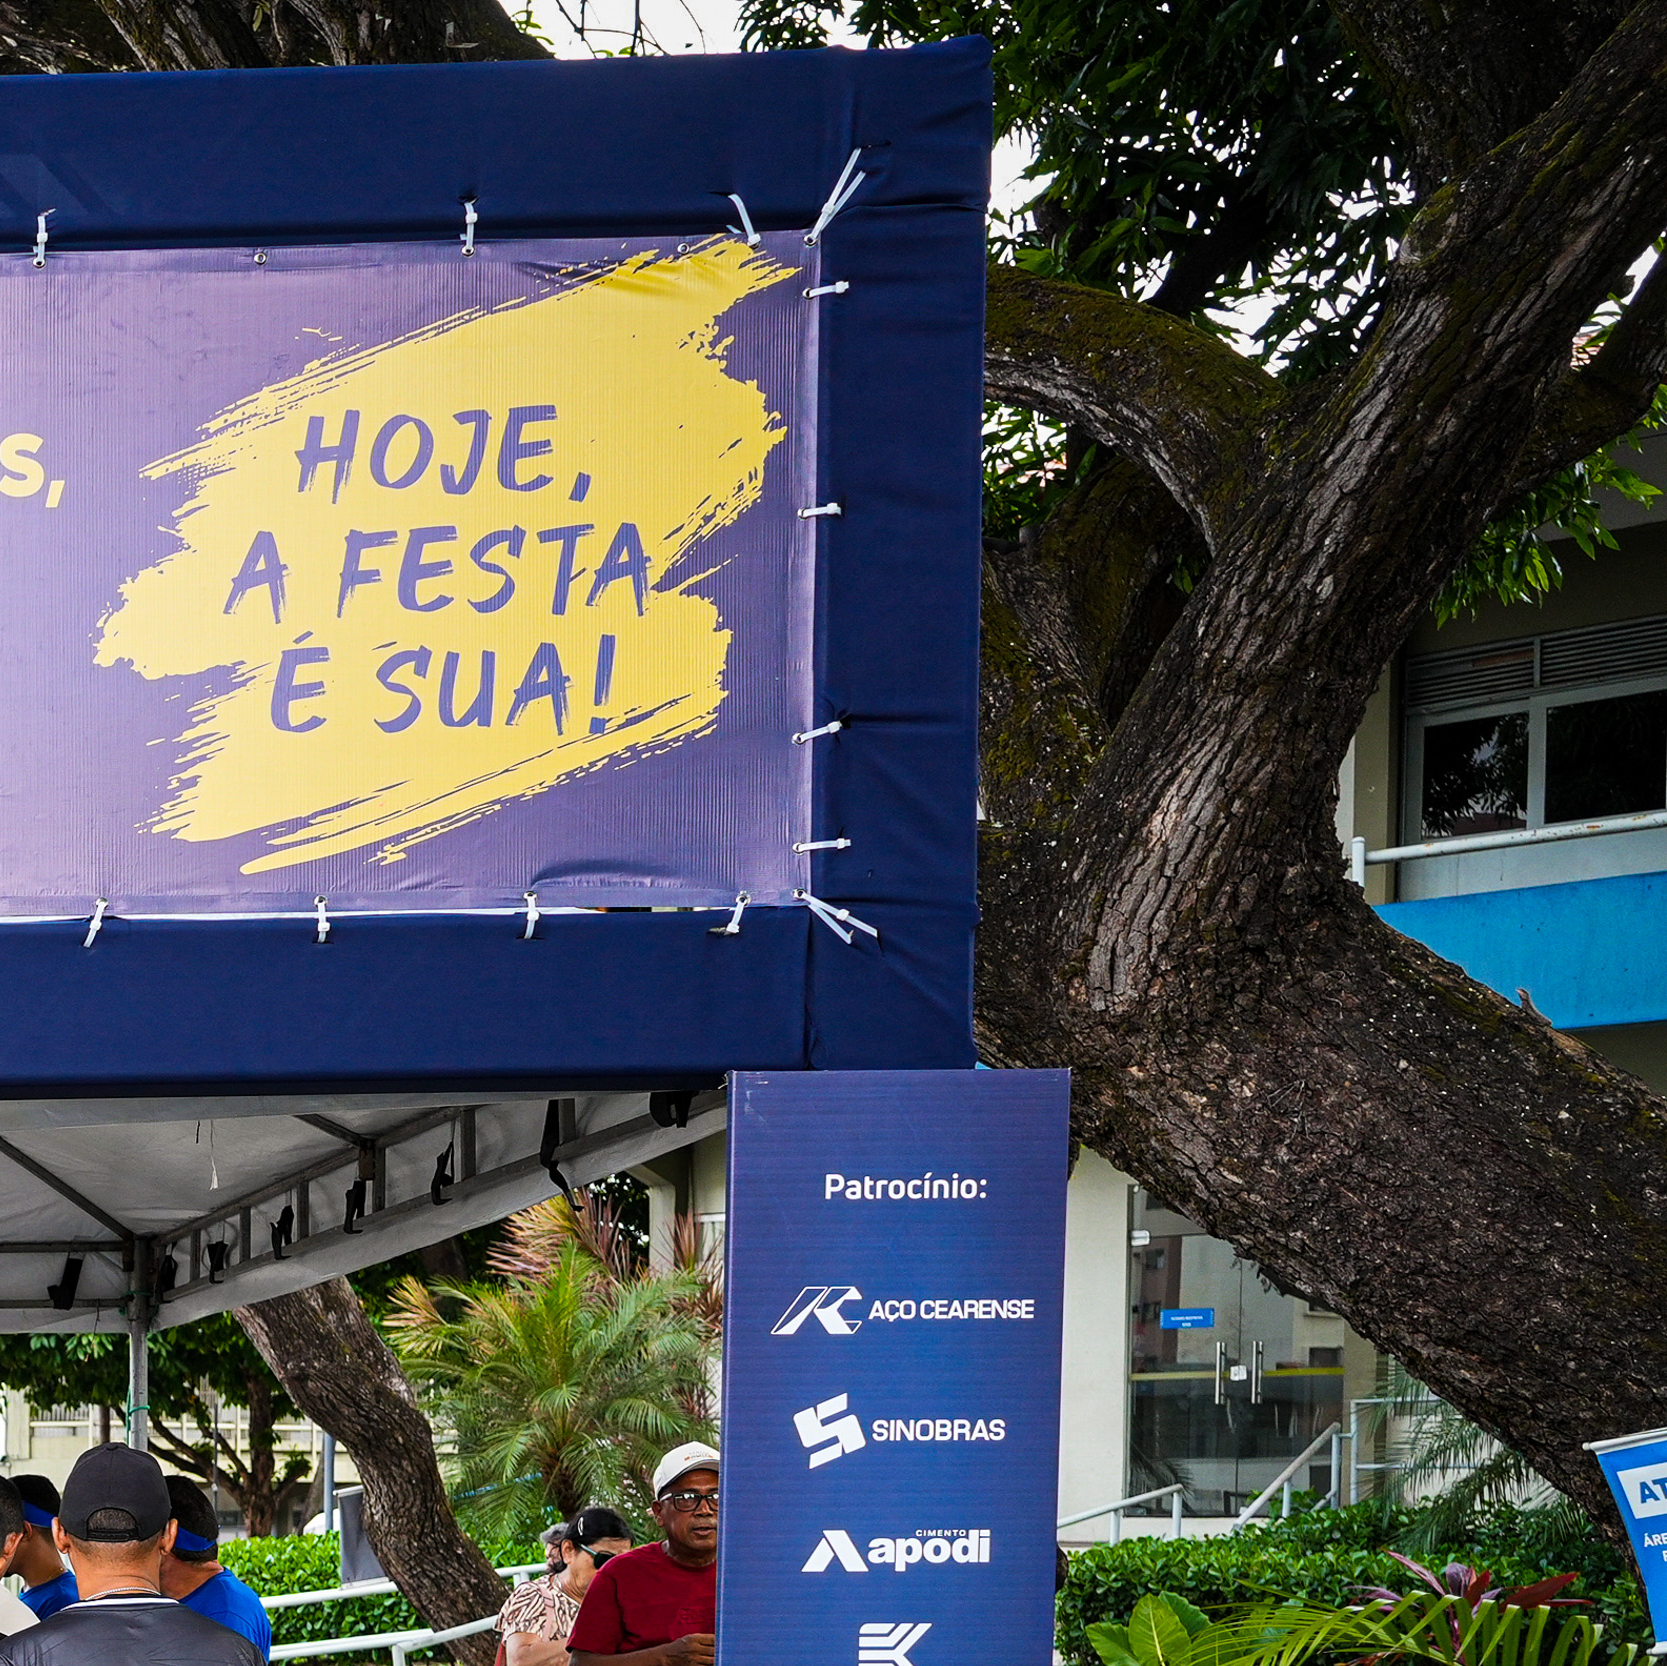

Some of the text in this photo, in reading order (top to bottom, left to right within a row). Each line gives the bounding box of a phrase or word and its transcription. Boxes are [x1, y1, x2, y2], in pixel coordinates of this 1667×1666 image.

[295, 404, 591, 503] HOJE,
[222, 522, 658, 624] A FESTA
[270, 631, 616, 735] É SUA!
[824, 1172, 987, 1200] Patrocínio:
[869, 1299, 1034, 1322] AÇO CEARENSE
[872, 1419, 1005, 1441] SINOBRAS
[1639, 1480, 1667, 1503] AT
[915, 1529, 966, 1537] CIMENTO
[1644, 1533, 1667, 1547] ÁRE
[868, 1529, 991, 1572] apodi
